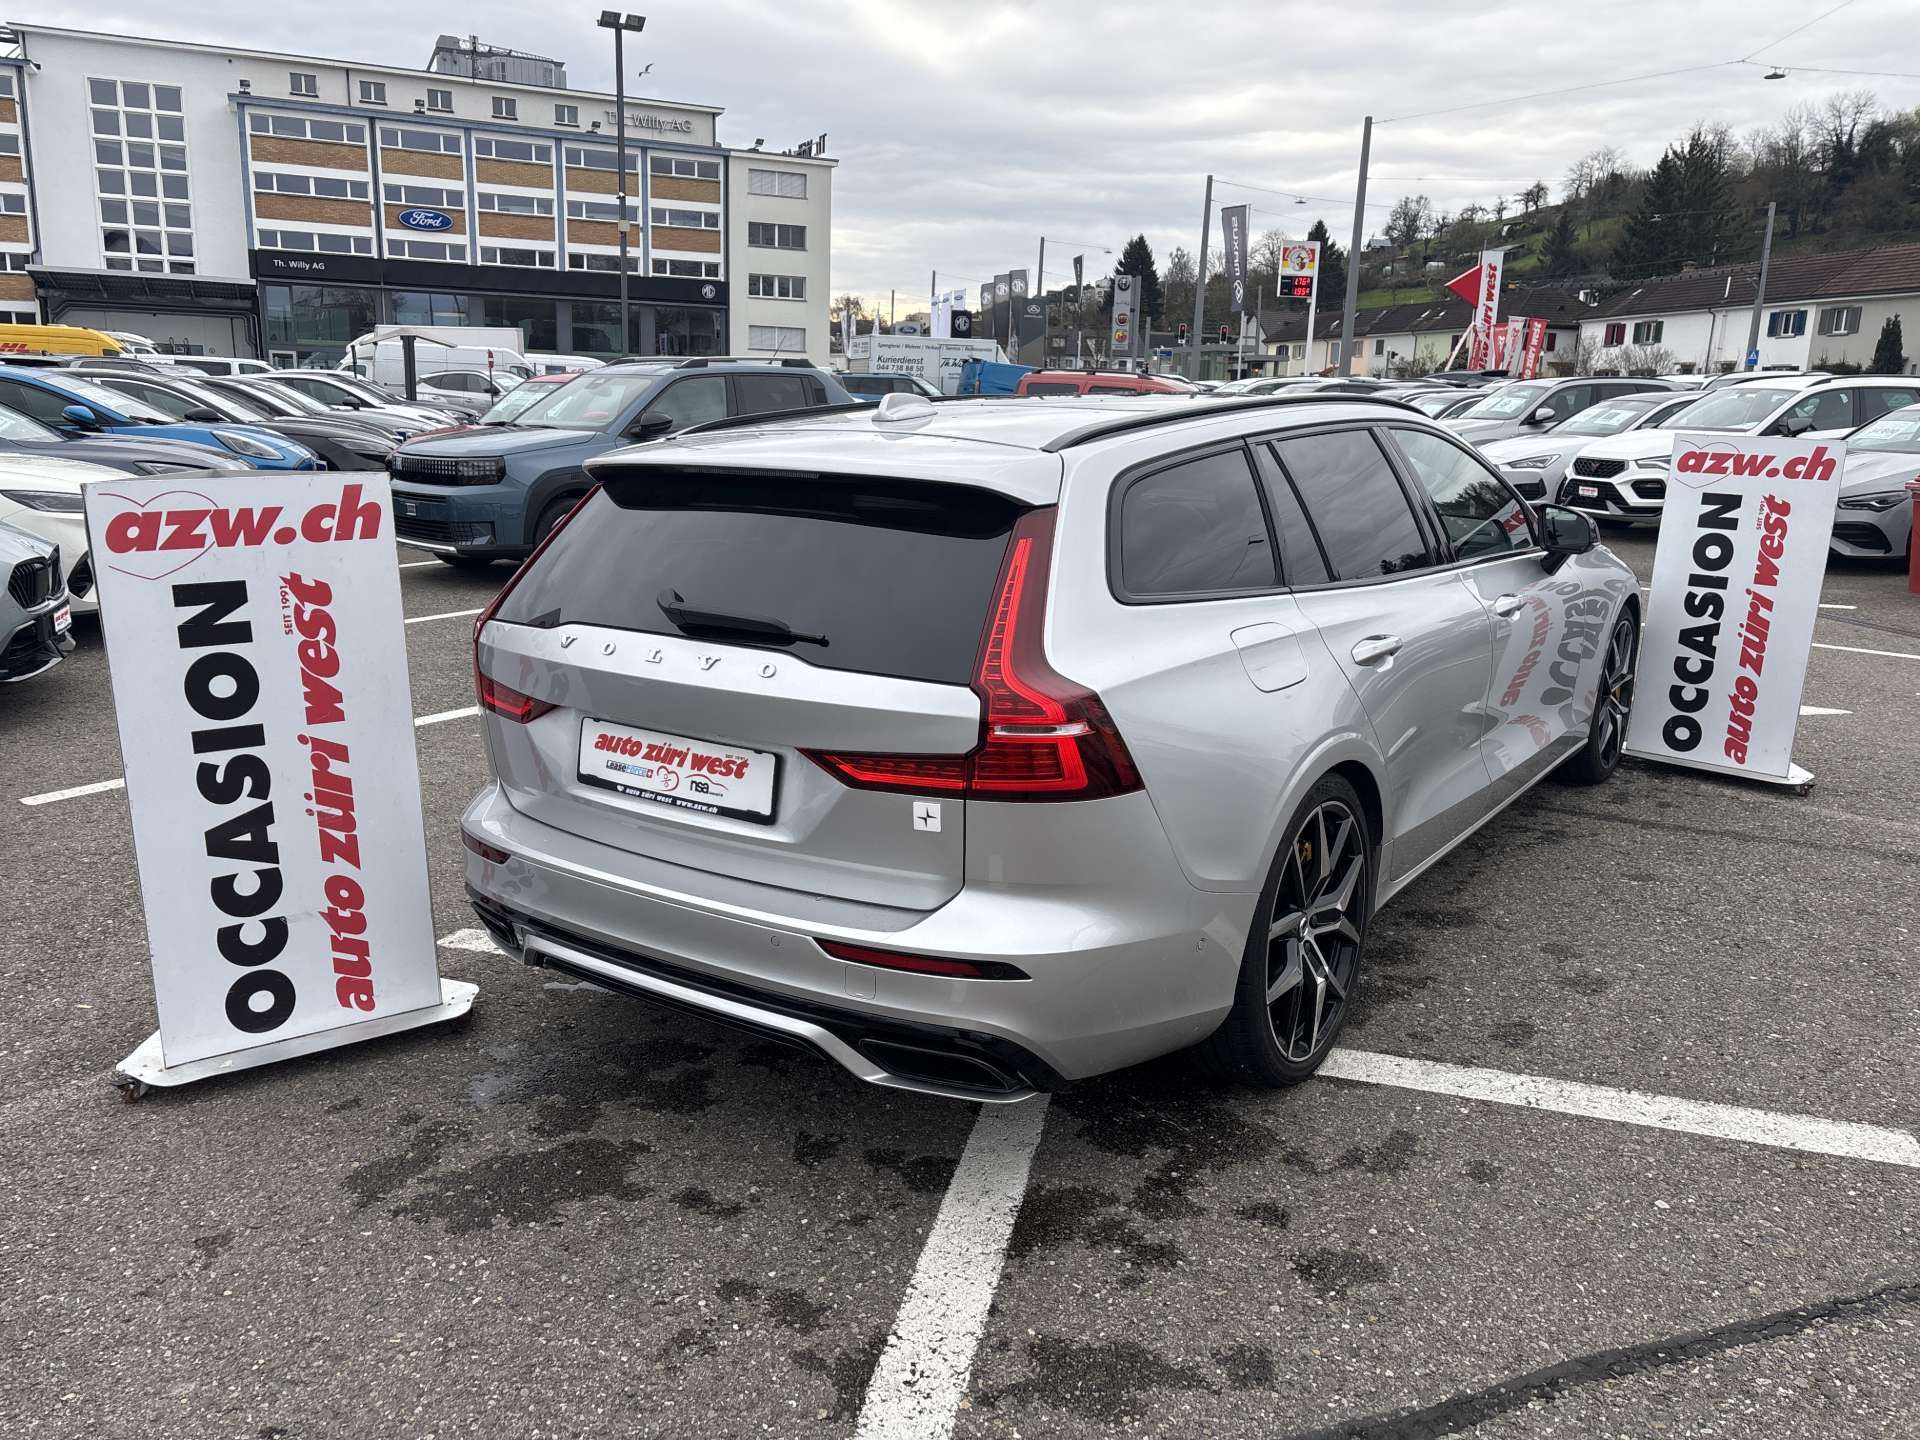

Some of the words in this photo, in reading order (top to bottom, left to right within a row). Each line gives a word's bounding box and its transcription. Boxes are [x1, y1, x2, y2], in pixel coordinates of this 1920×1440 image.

[633, 113, 667, 133] Willy
[671, 118, 692, 133] AG
[410, 211, 442, 227] Ford
[273, 259, 287, 268] Th.
[289, 260, 311, 271] Willy
[312, 262, 325, 270] AG
[1485, 263, 1497, 302] west
[702, 284, 715, 298] MG
[955, 315, 969, 331] MG
[877, 354, 924, 365] Kurierdienst
[1676, 447, 1836, 481] azw.ch
[105, 484, 381, 553] azw.ch
[1755, 495, 1791, 587] west
[279, 585, 290, 610] 1991
[283, 613, 294, 636] SEIT
[1663, 493, 1742, 752] OCCASION
[1738, 592, 1773, 676] züri
[279, 572, 345, 725] west
[561, 633, 776, 678] VOLVO
[1725, 677, 1757, 765] auto
[595, 733, 642, 755] auto
[641, 742, 690, 768] züri
[689, 752, 749, 779] west
[297, 735, 361, 869] züri
[626, 788, 640, 797] auto
[641, 790, 656, 800] züri
[657, 792, 673, 803] west
[676, 795, 718, 813] www.azw.ch
[690, 780, 709, 795] nsa
[172, 581, 296, 1034] OCCASION
[318, 876, 375, 1012] auto
